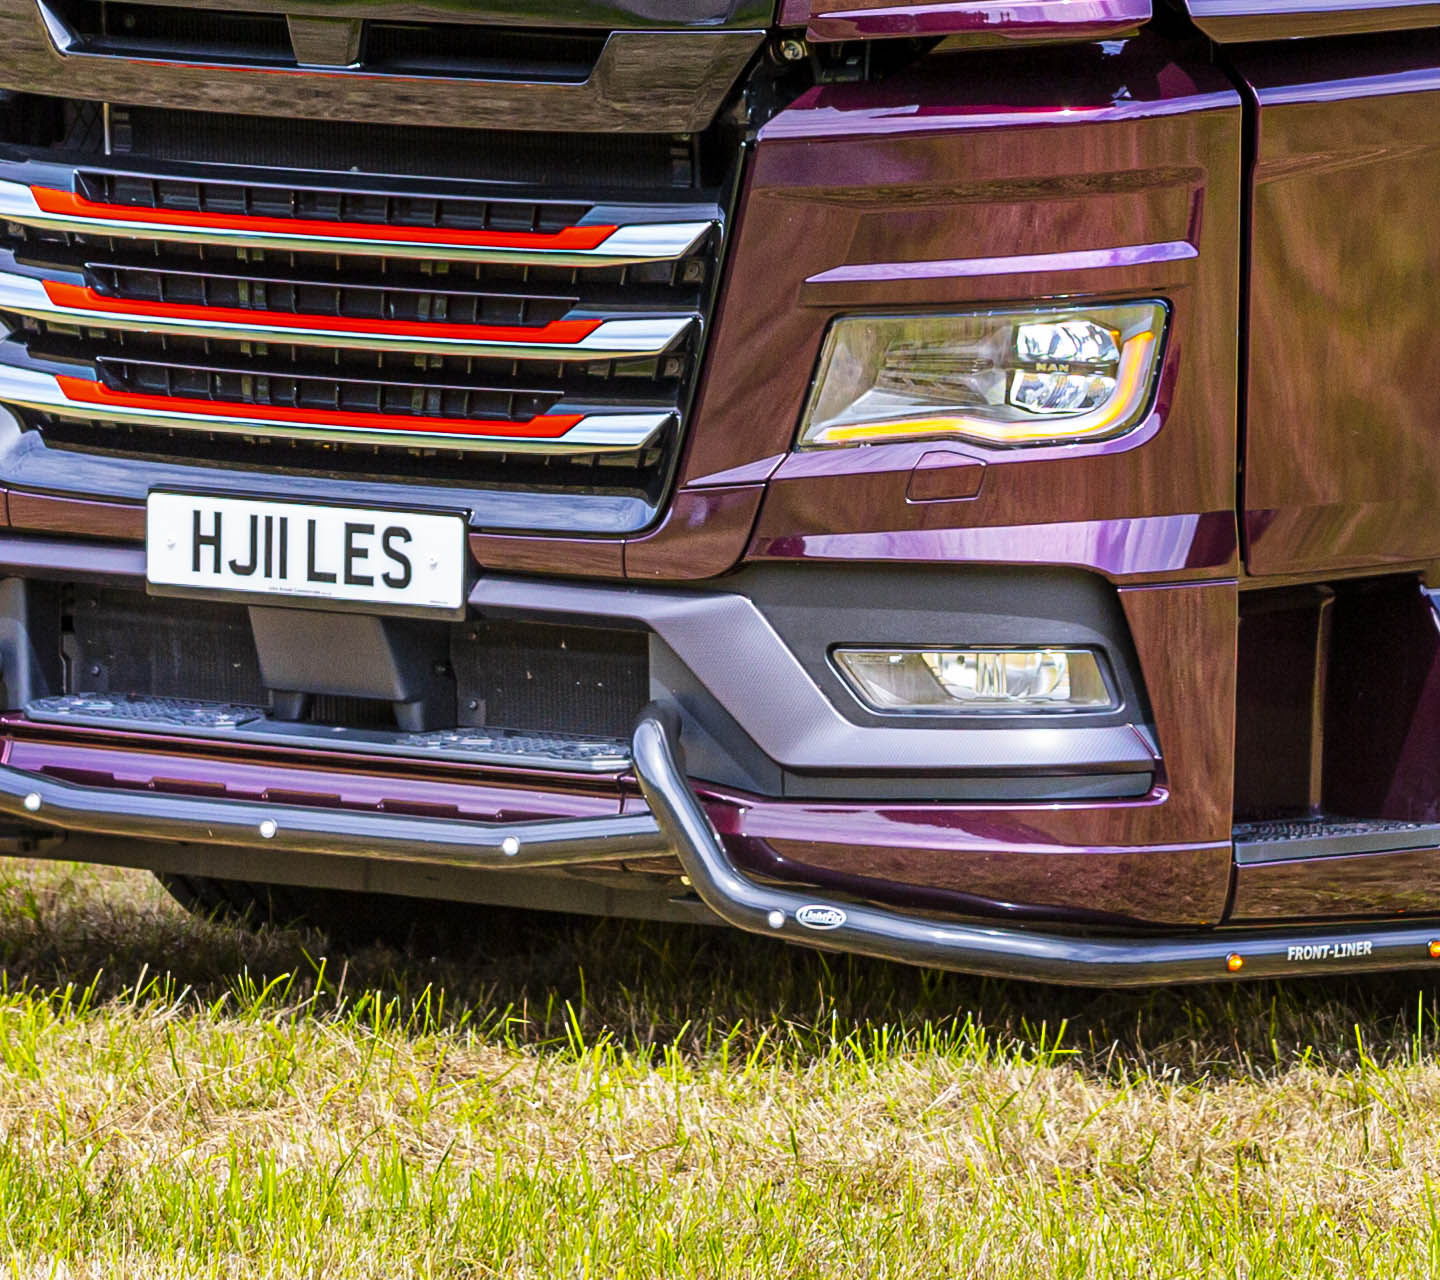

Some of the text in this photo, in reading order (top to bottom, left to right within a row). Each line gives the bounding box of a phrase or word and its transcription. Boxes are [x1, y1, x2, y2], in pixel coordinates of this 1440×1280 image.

[1035, 362, 1070, 373] MAN
[307, 518, 413, 590] LES
[1287, 940, 1373, 961] FRONT-LINER
